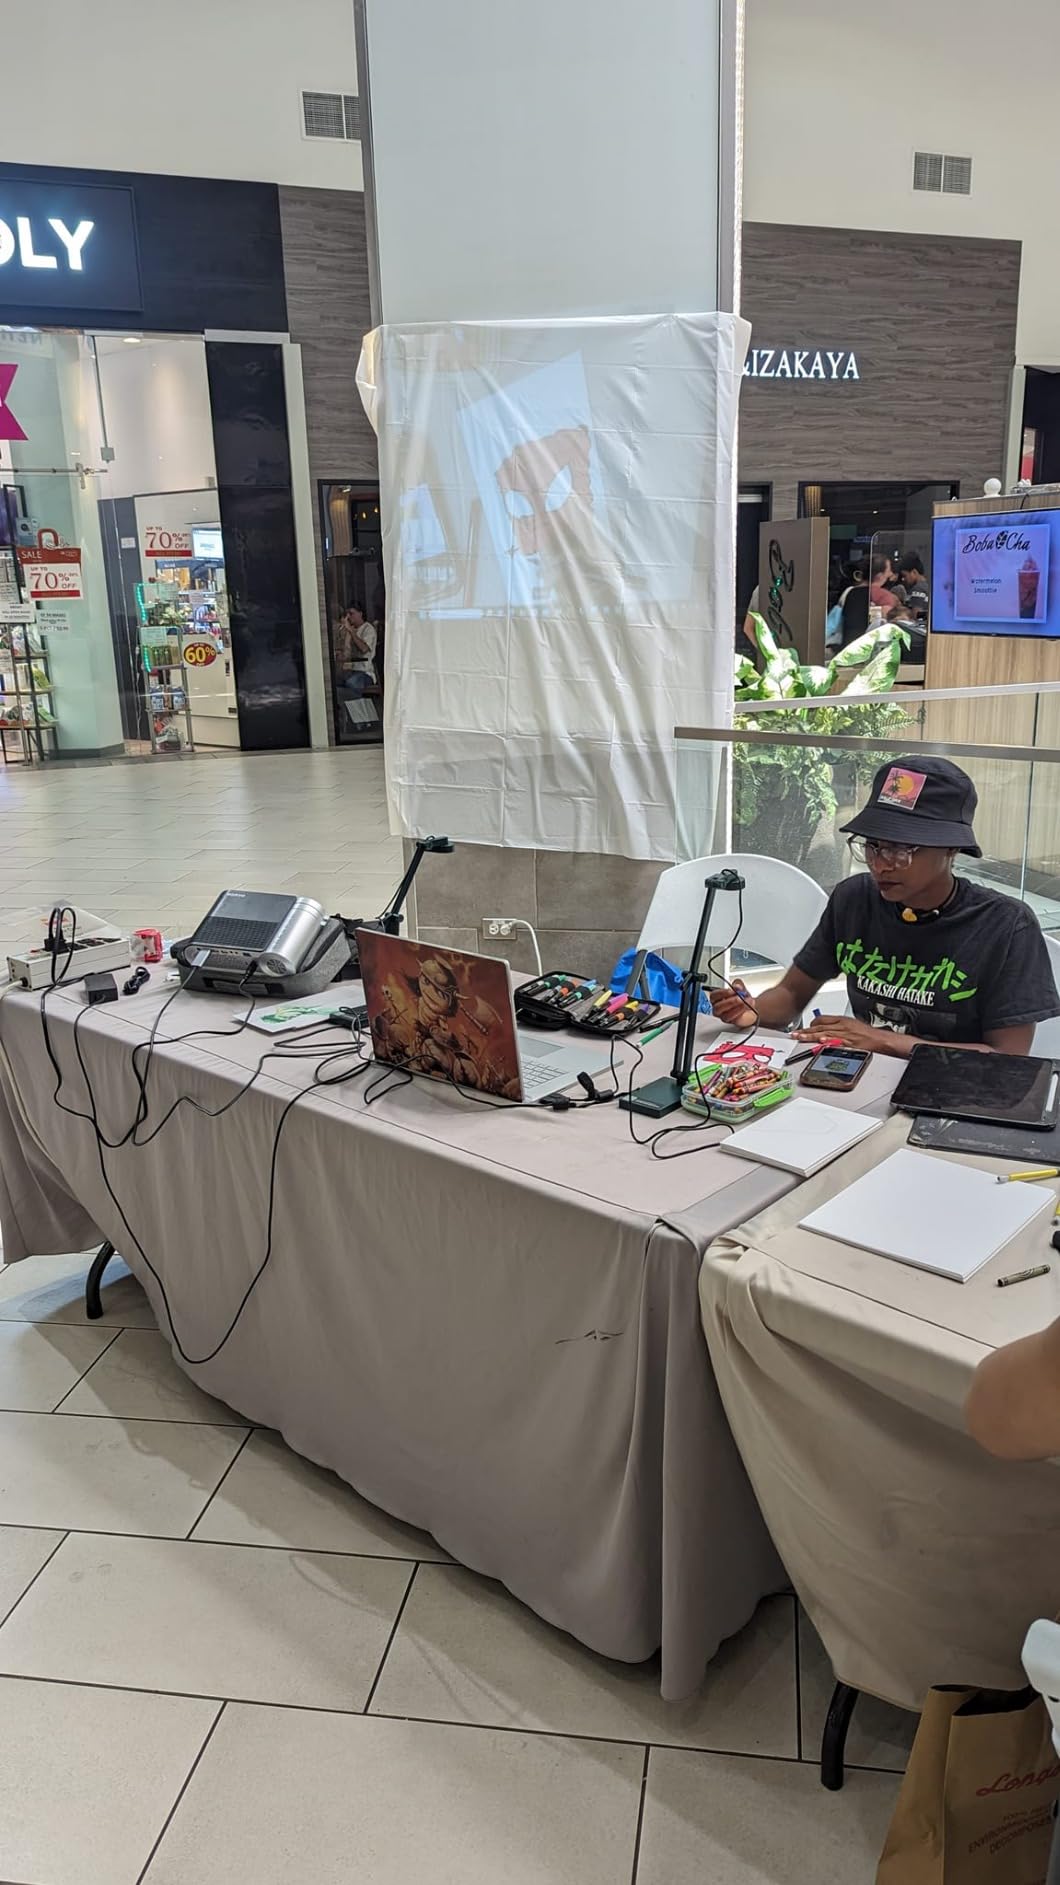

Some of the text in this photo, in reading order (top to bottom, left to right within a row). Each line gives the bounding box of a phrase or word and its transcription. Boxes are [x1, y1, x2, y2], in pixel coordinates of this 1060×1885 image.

[0, 216, 95, 271] LY
[145, 531, 183, 549] 70%
[962, 531, 1031, 554] Boba Cha
[21, 550, 42, 559] SALE
[30, 571, 70, 589] 70%
[185, 646, 216, 663] 60%
[857, 975, 936, 1006] KAKASHI HATAKE
